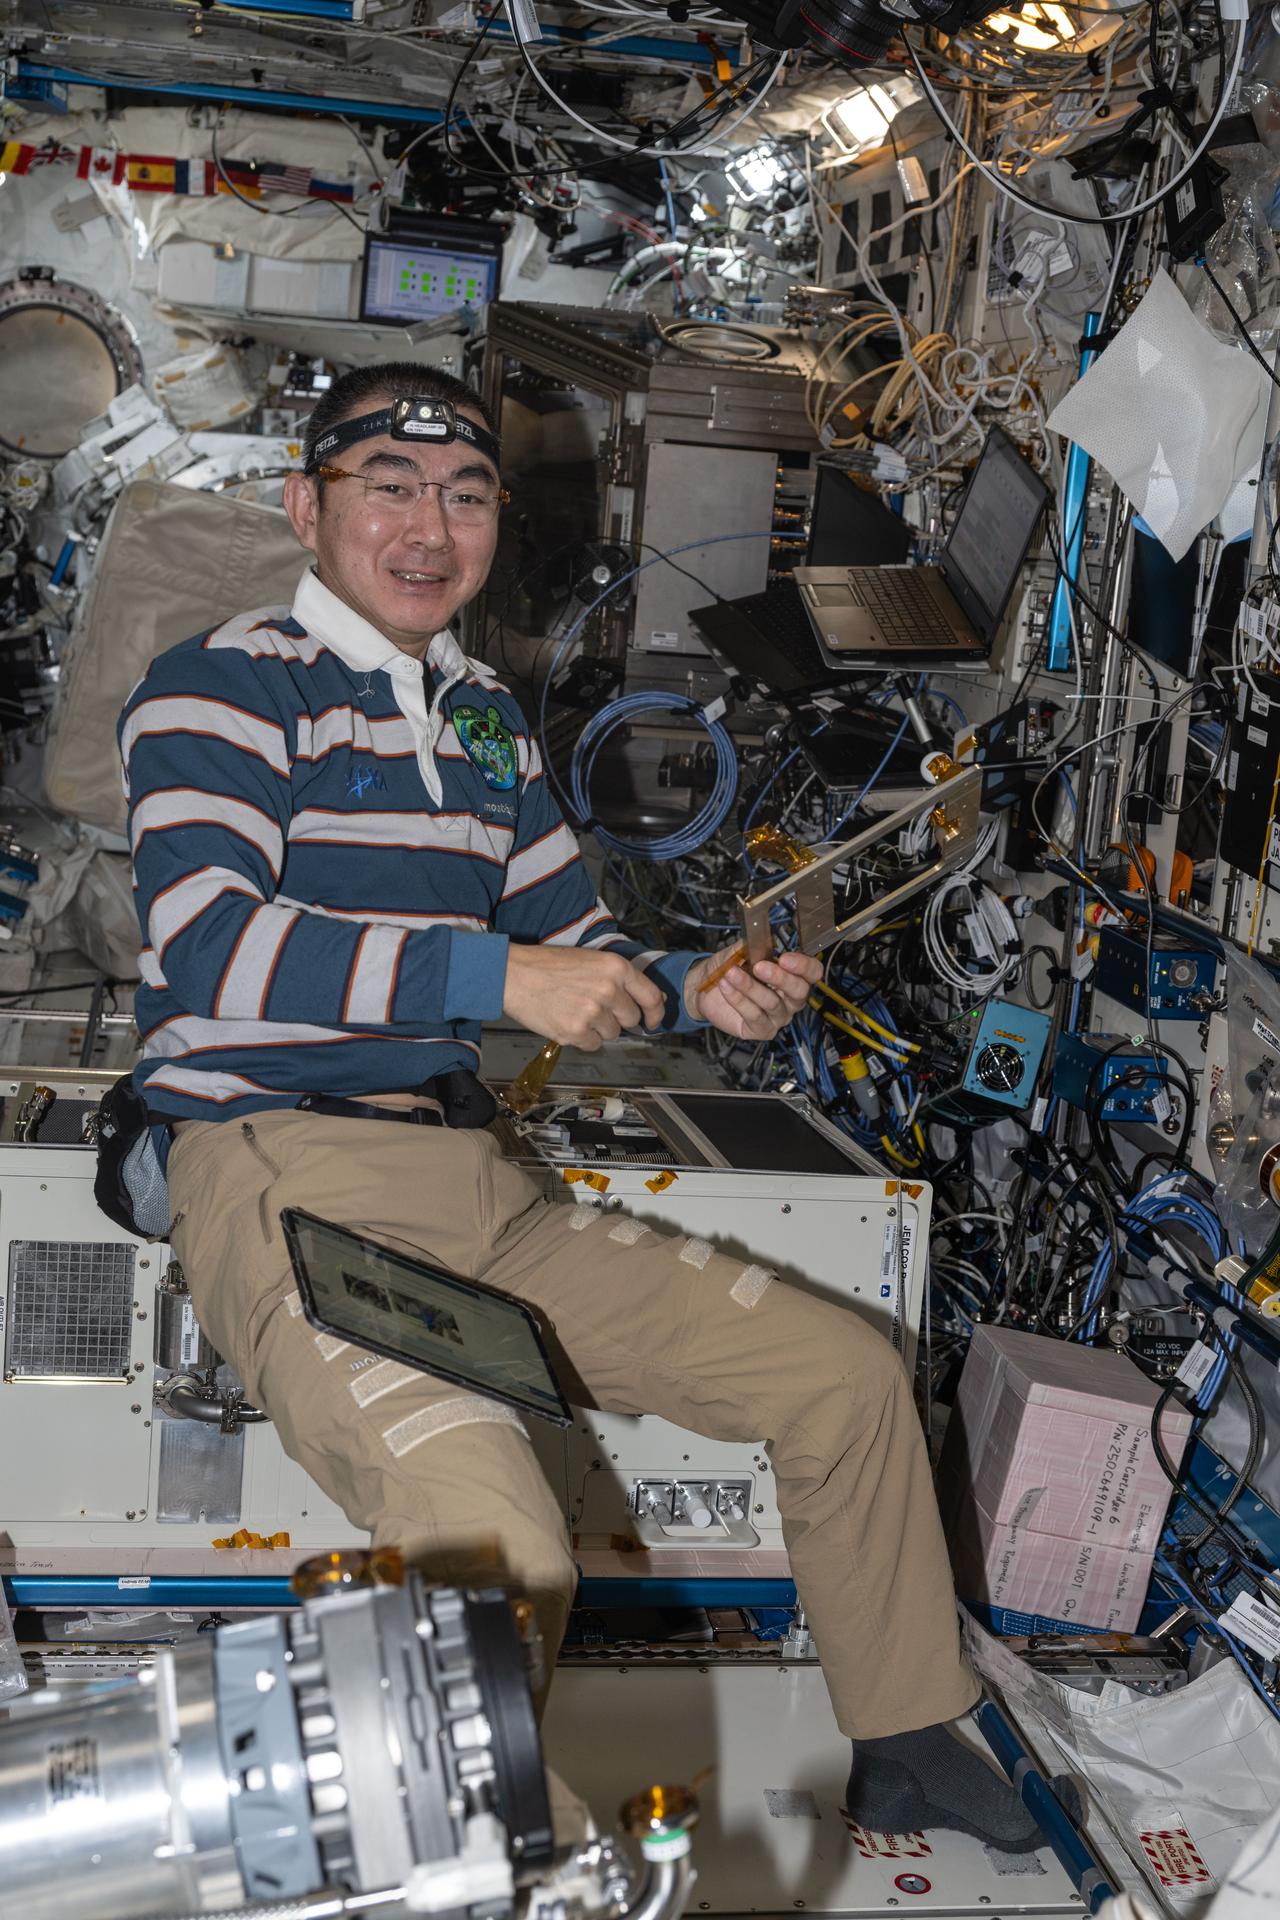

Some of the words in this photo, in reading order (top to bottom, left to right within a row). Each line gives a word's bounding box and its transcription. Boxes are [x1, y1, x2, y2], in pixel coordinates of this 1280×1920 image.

[456, 421, 476, 440] ETZL
[314, 434, 339, 459] PETZL
[901, 1225, 911, 1246] JEM
[1127, 1428, 1148, 1465] Sample
[1111, 1466, 1136, 1513] Cartridge
[1163, 1840, 1179, 1857] PORT
[1173, 1858, 1187, 1873] FIRE
